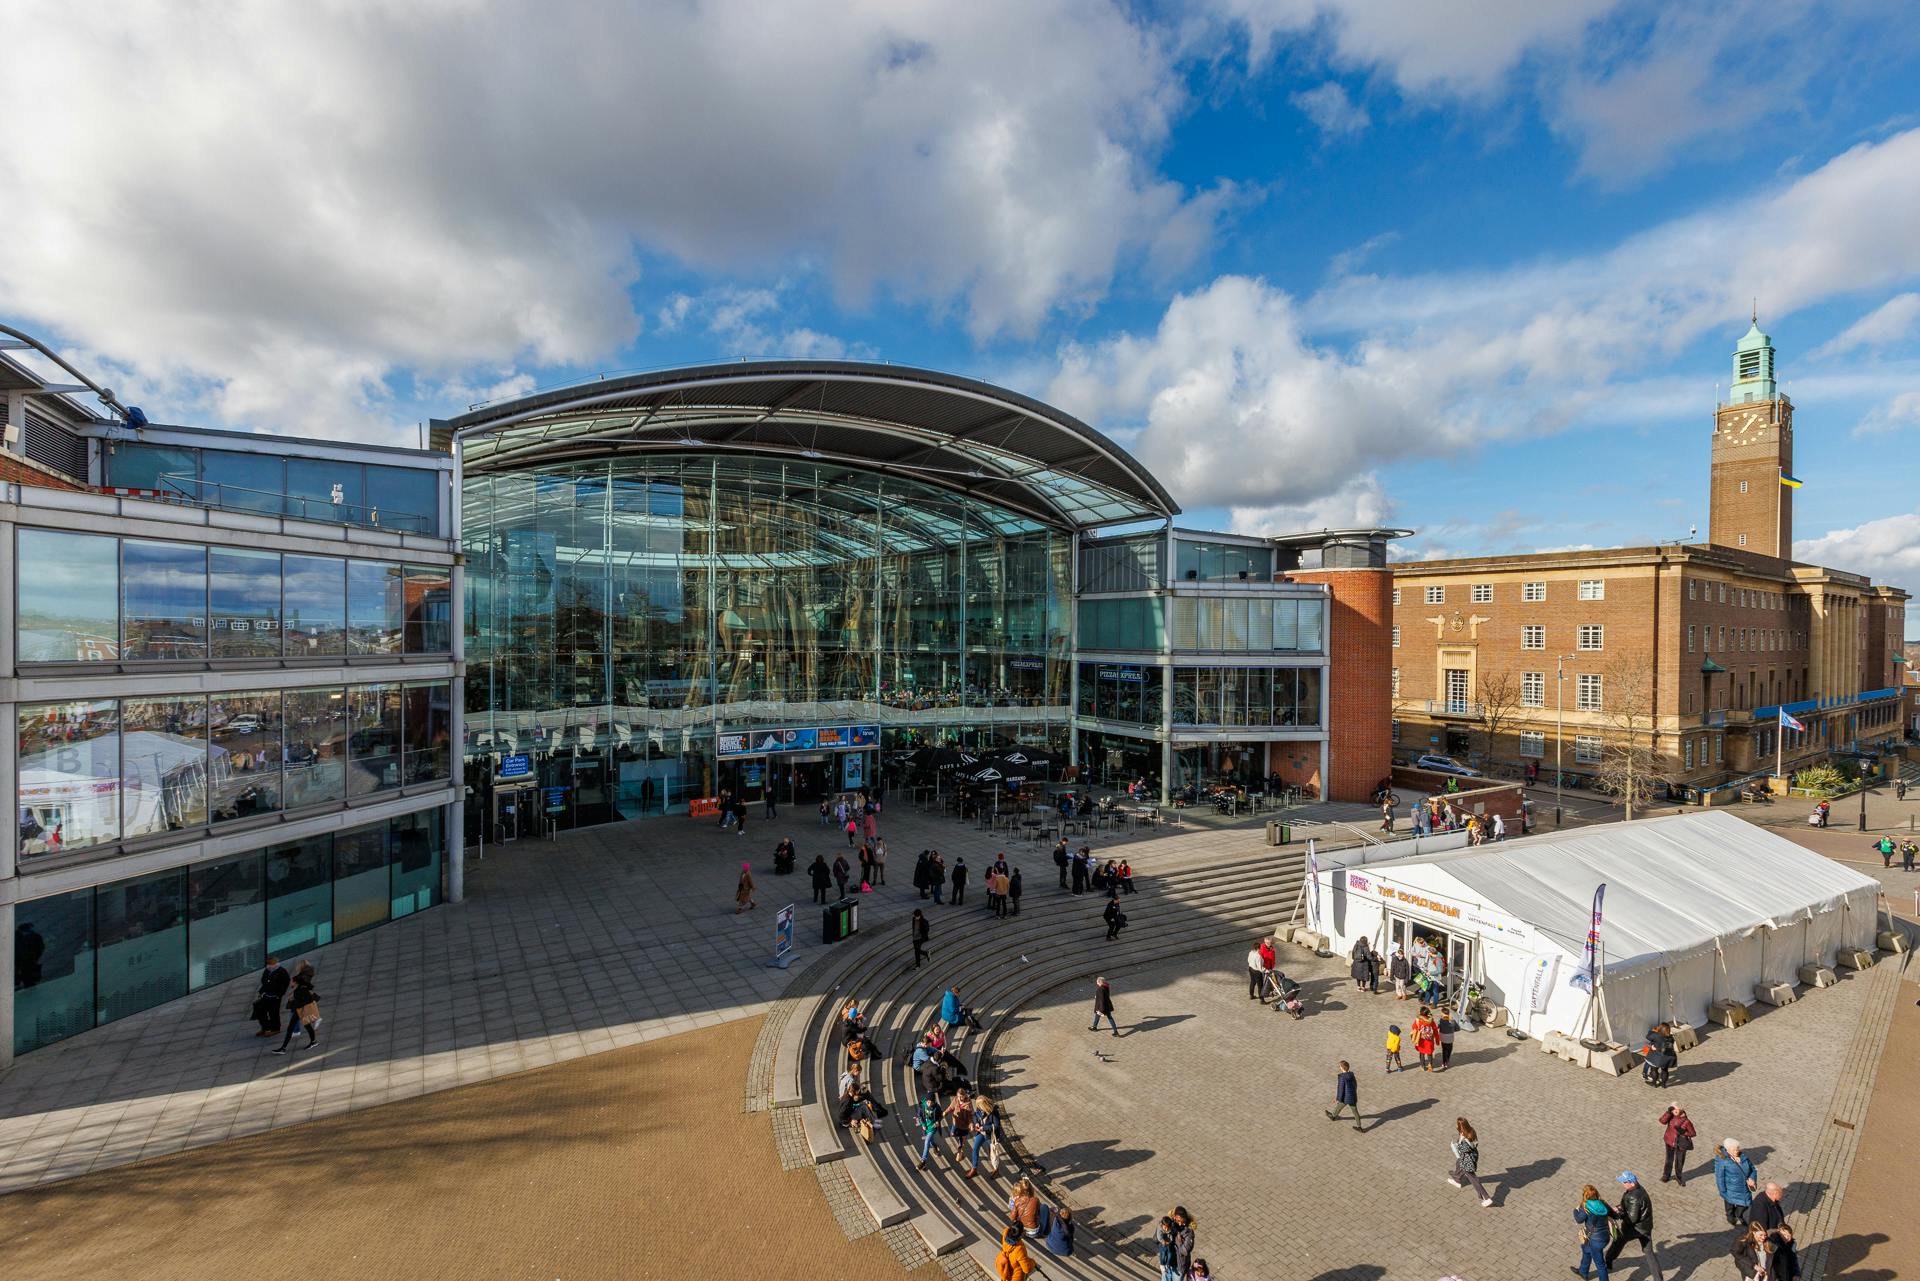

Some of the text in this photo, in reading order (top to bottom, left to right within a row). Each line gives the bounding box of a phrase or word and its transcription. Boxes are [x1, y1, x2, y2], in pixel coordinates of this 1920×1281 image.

[1377, 885, 1396, 898] THE
[1468, 916, 1496, 929] VATTENFALL
[1531, 968, 1544, 1008] VATTENFALL
